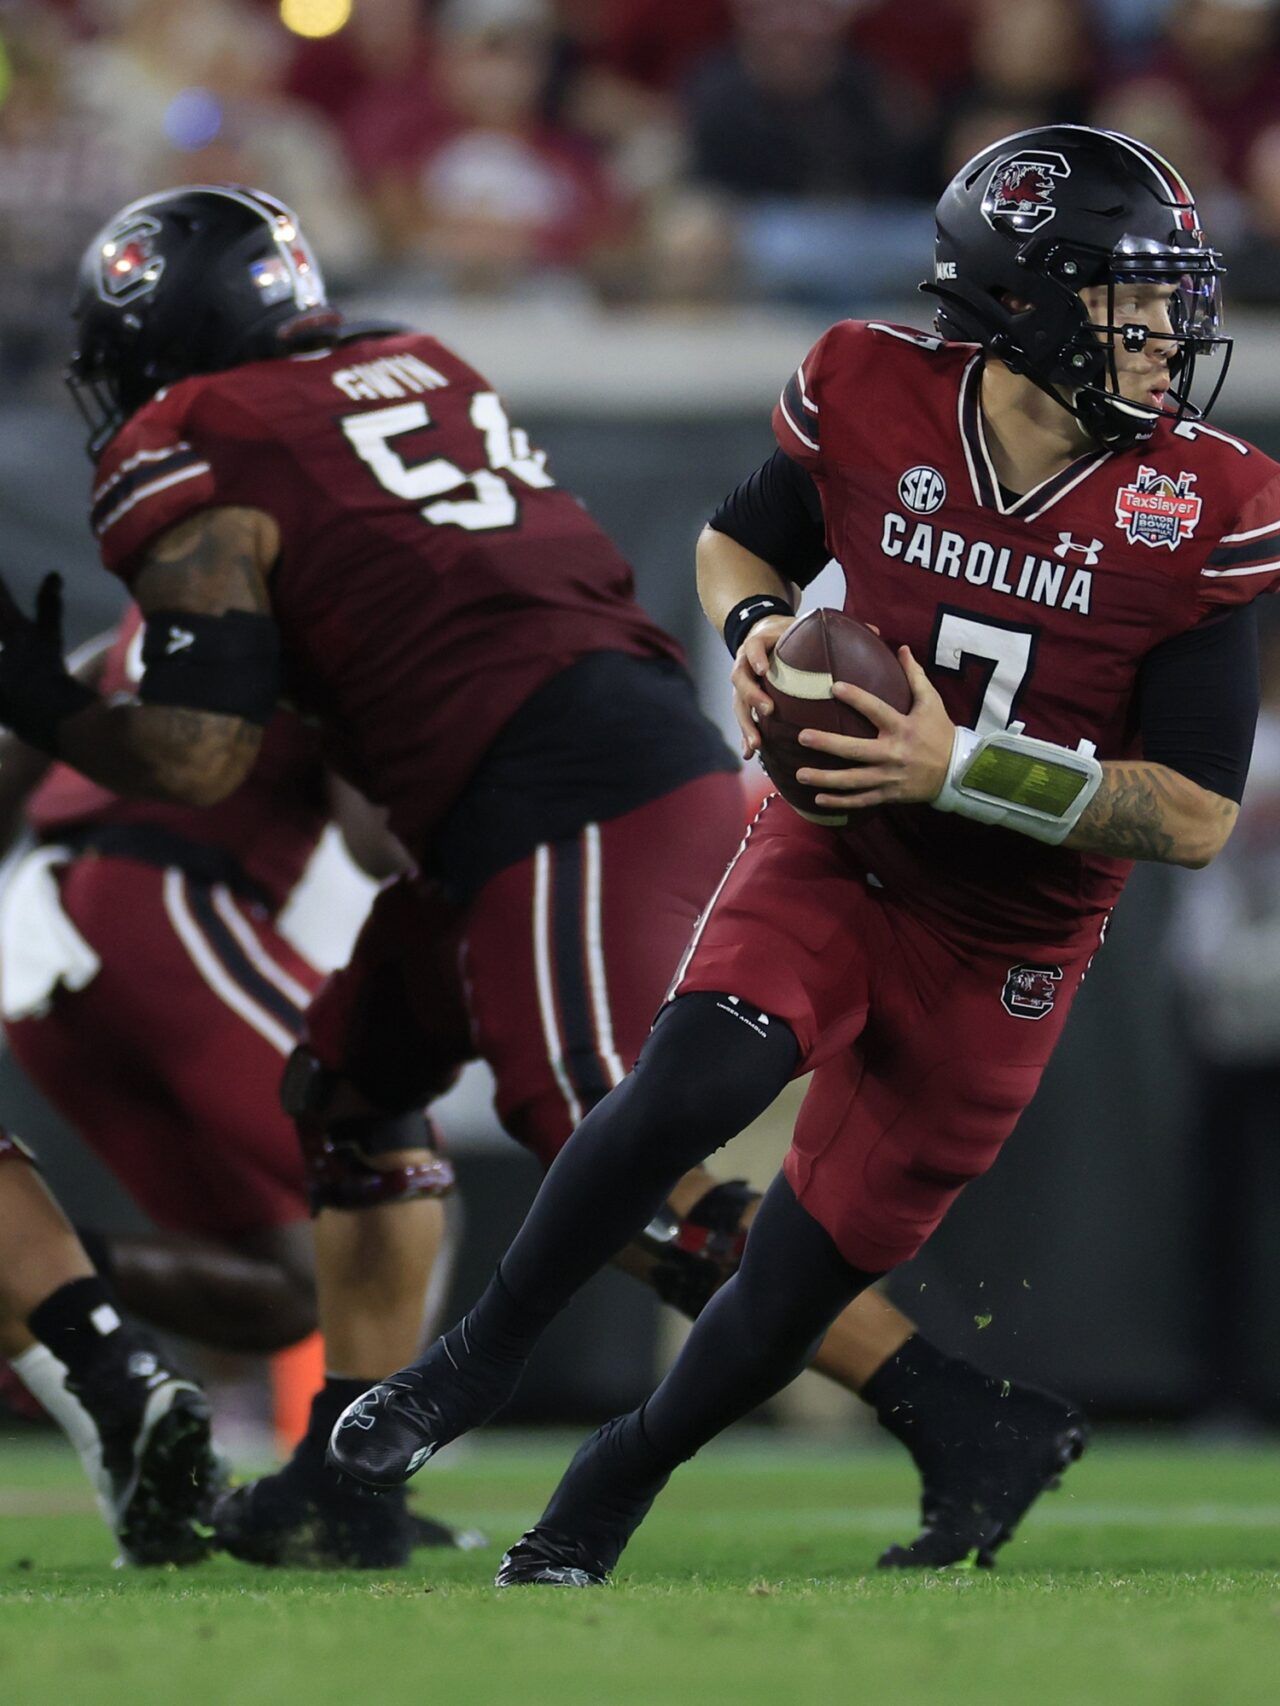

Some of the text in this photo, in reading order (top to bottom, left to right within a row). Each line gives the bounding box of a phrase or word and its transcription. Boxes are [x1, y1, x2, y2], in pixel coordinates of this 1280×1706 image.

[332, 353, 449, 401] GWYN
[341, 391, 556, 531] 54
[902, 469, 943, 511] SEC
[1124, 492, 1194, 515] TaxSlayer
[1138, 520, 1173, 531] BOWL
[1139, 513, 1174, 526] GATOR
[880, 512, 1093, 616] CAROLINA
[934, 613, 1033, 736] 7
